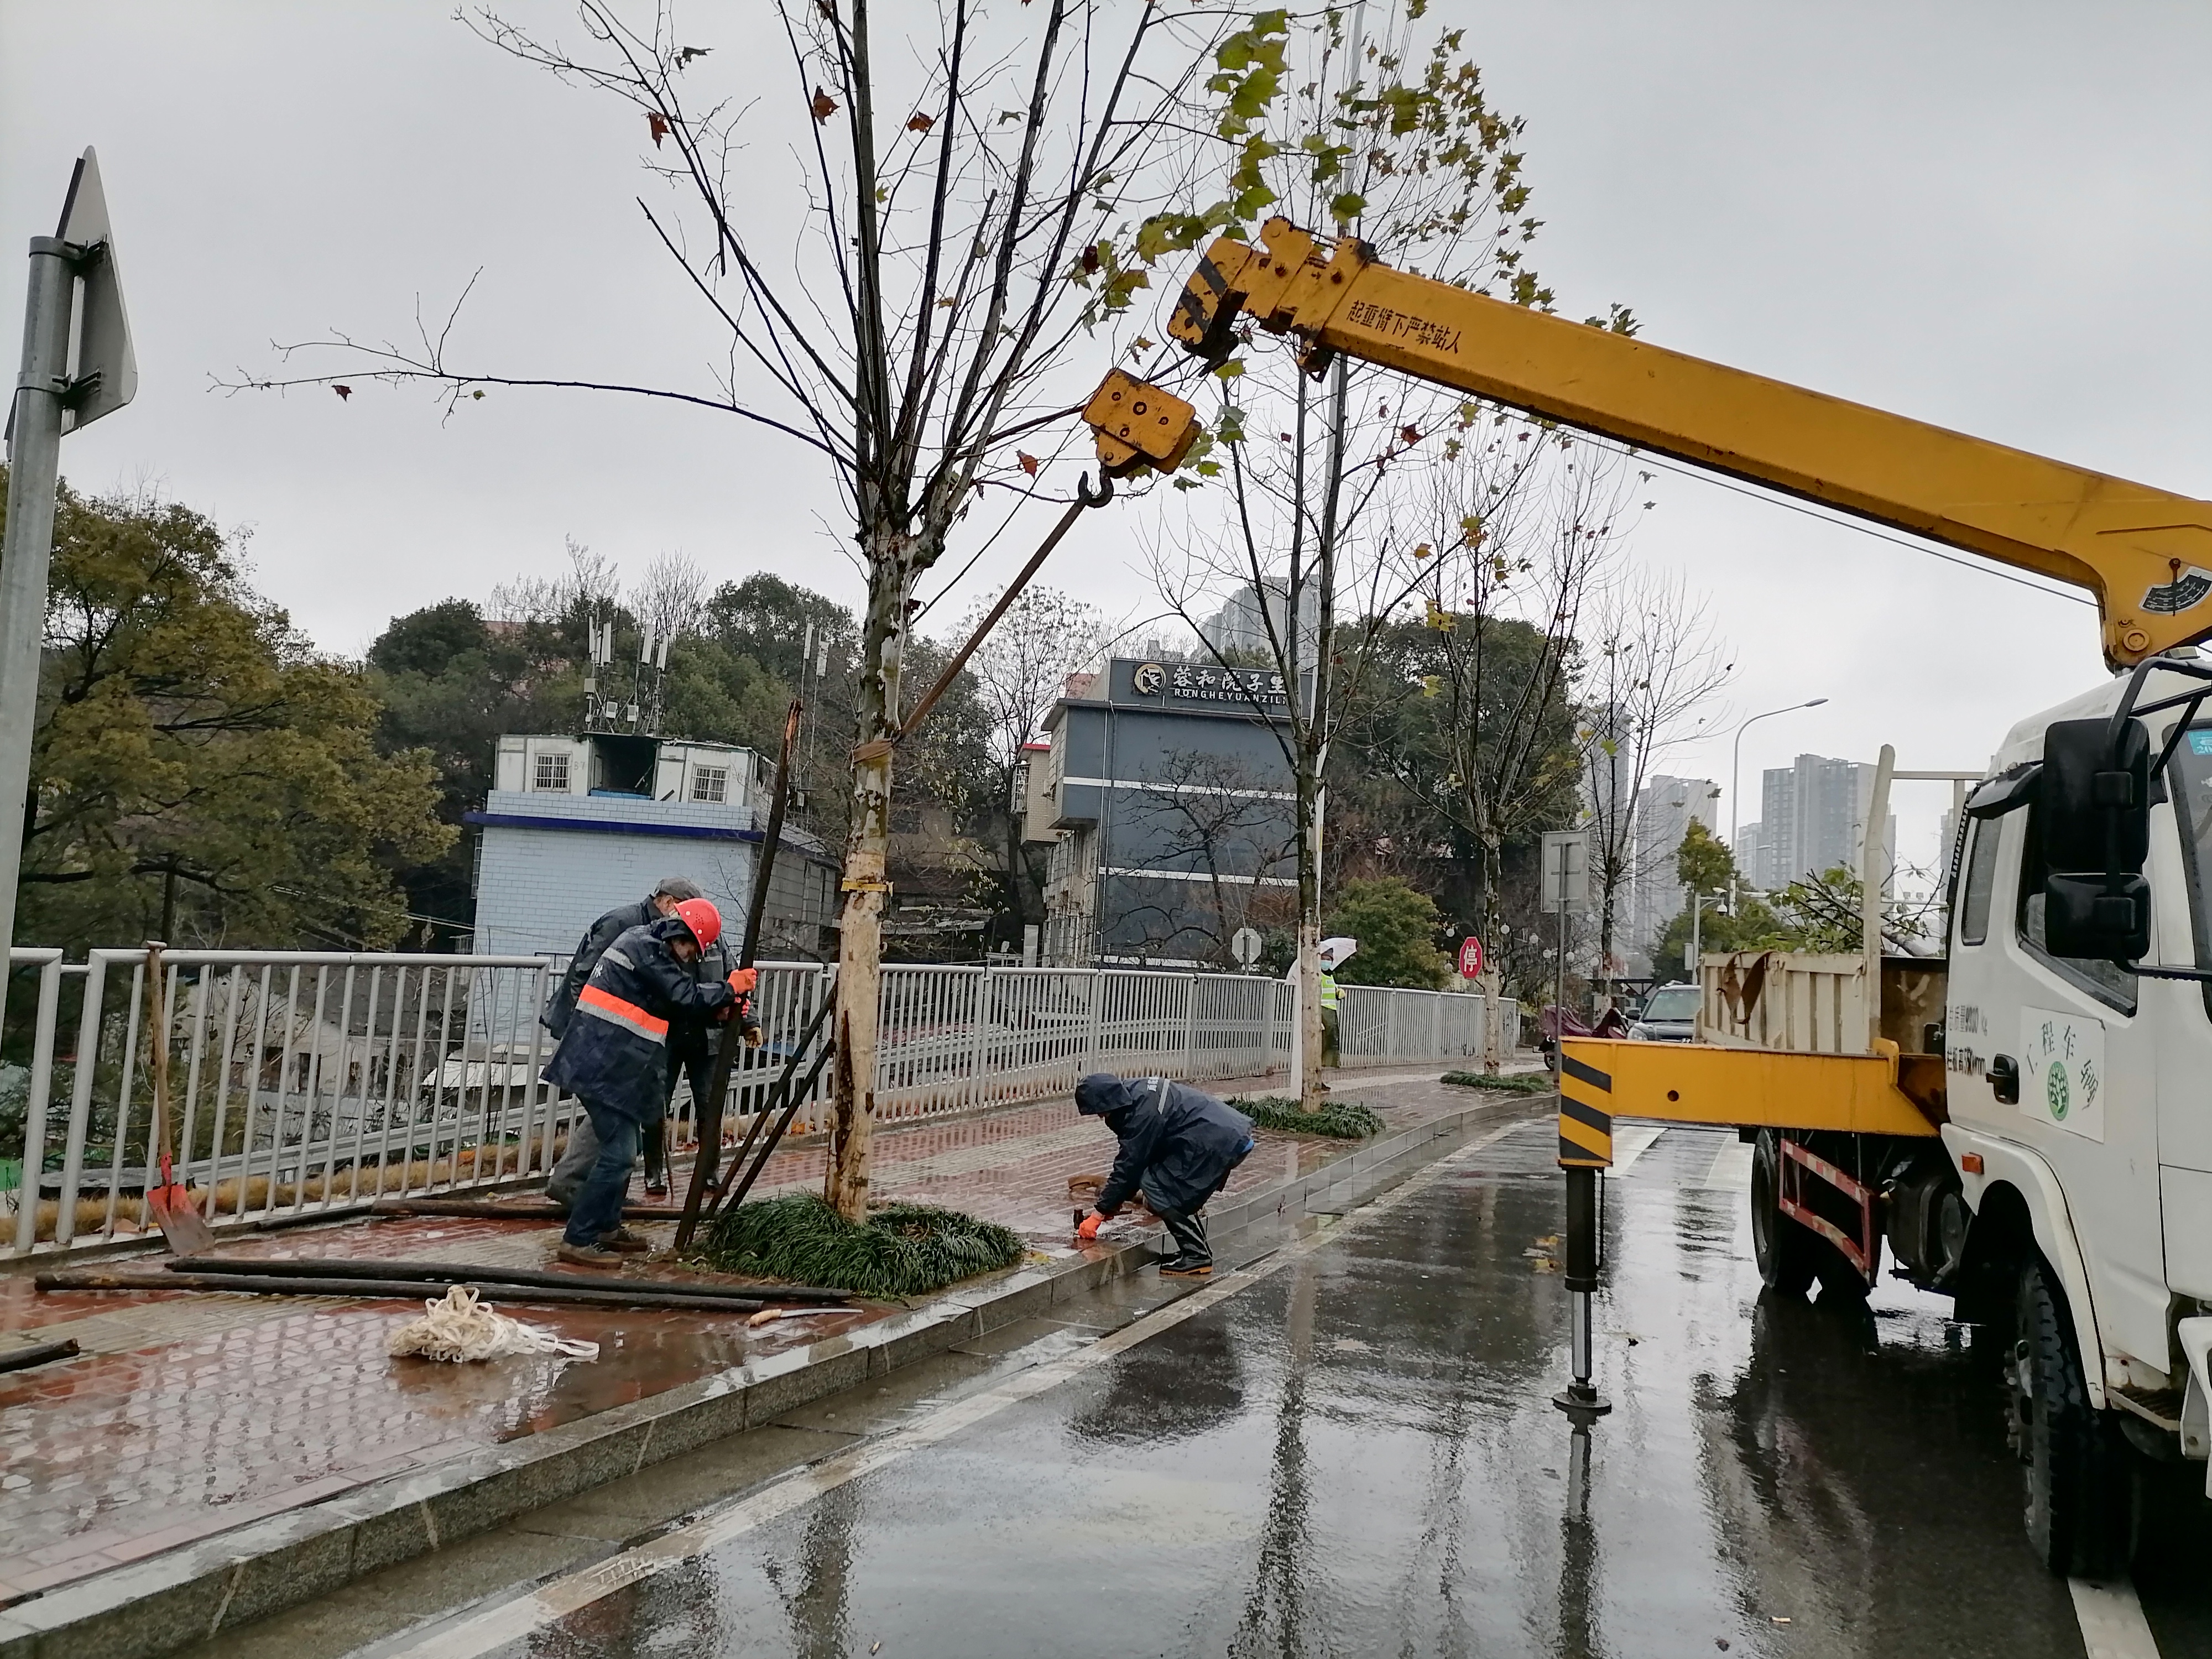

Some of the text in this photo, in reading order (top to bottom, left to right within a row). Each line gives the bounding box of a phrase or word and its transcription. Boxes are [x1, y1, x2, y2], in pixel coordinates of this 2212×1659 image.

[1347, 299, 1462, 354] 起重臂下严禁站人
[1173, 665, 1287, 694] 蓉和院子里
[1463, 944, 1478, 972] 停
